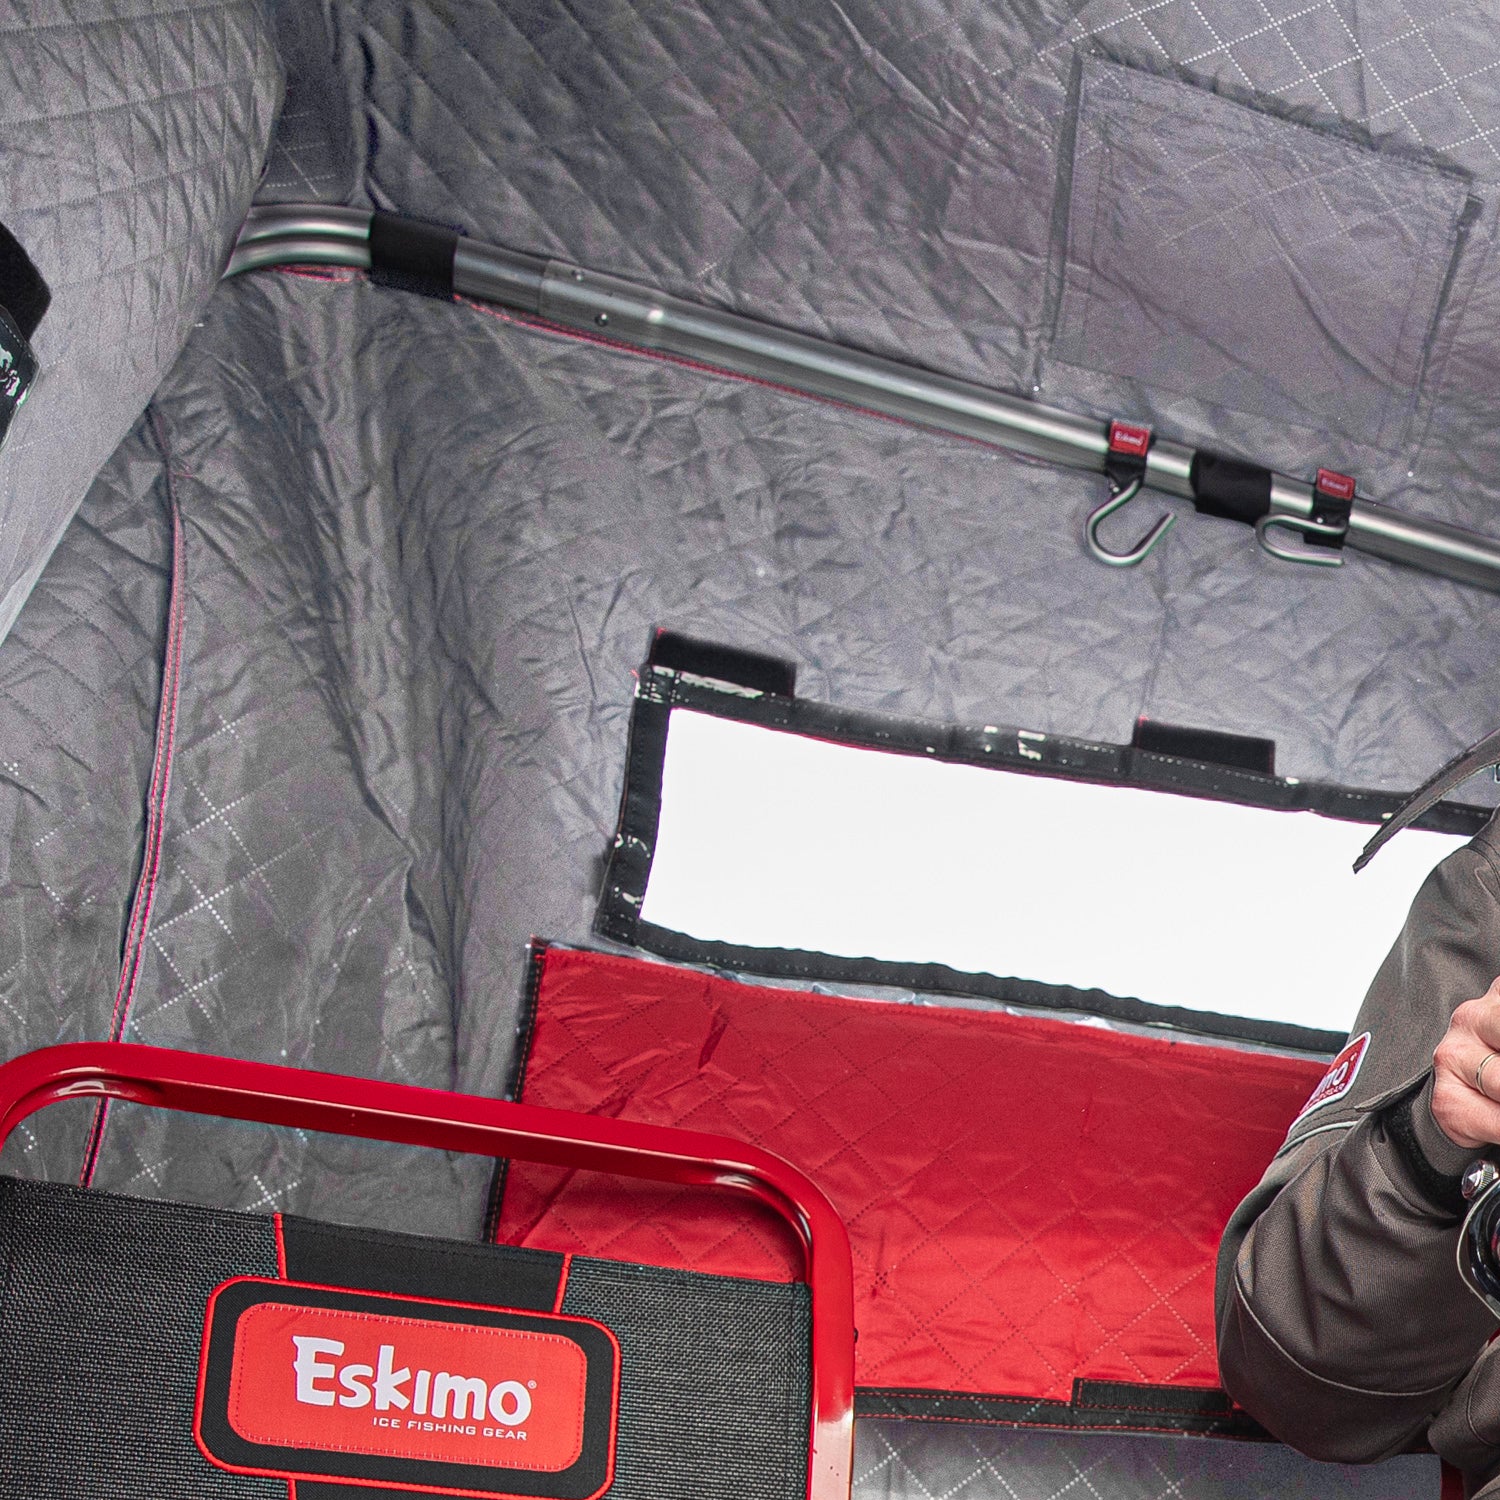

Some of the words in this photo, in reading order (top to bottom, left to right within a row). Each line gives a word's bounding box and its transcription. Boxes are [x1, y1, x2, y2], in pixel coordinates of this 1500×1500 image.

[292, 1335, 533, 1426] Eskimo
[373, 1417, 401, 1429] ICE
[407, 1420, 476, 1436] FISHING
[482, 1427, 528, 1441] GEAR
